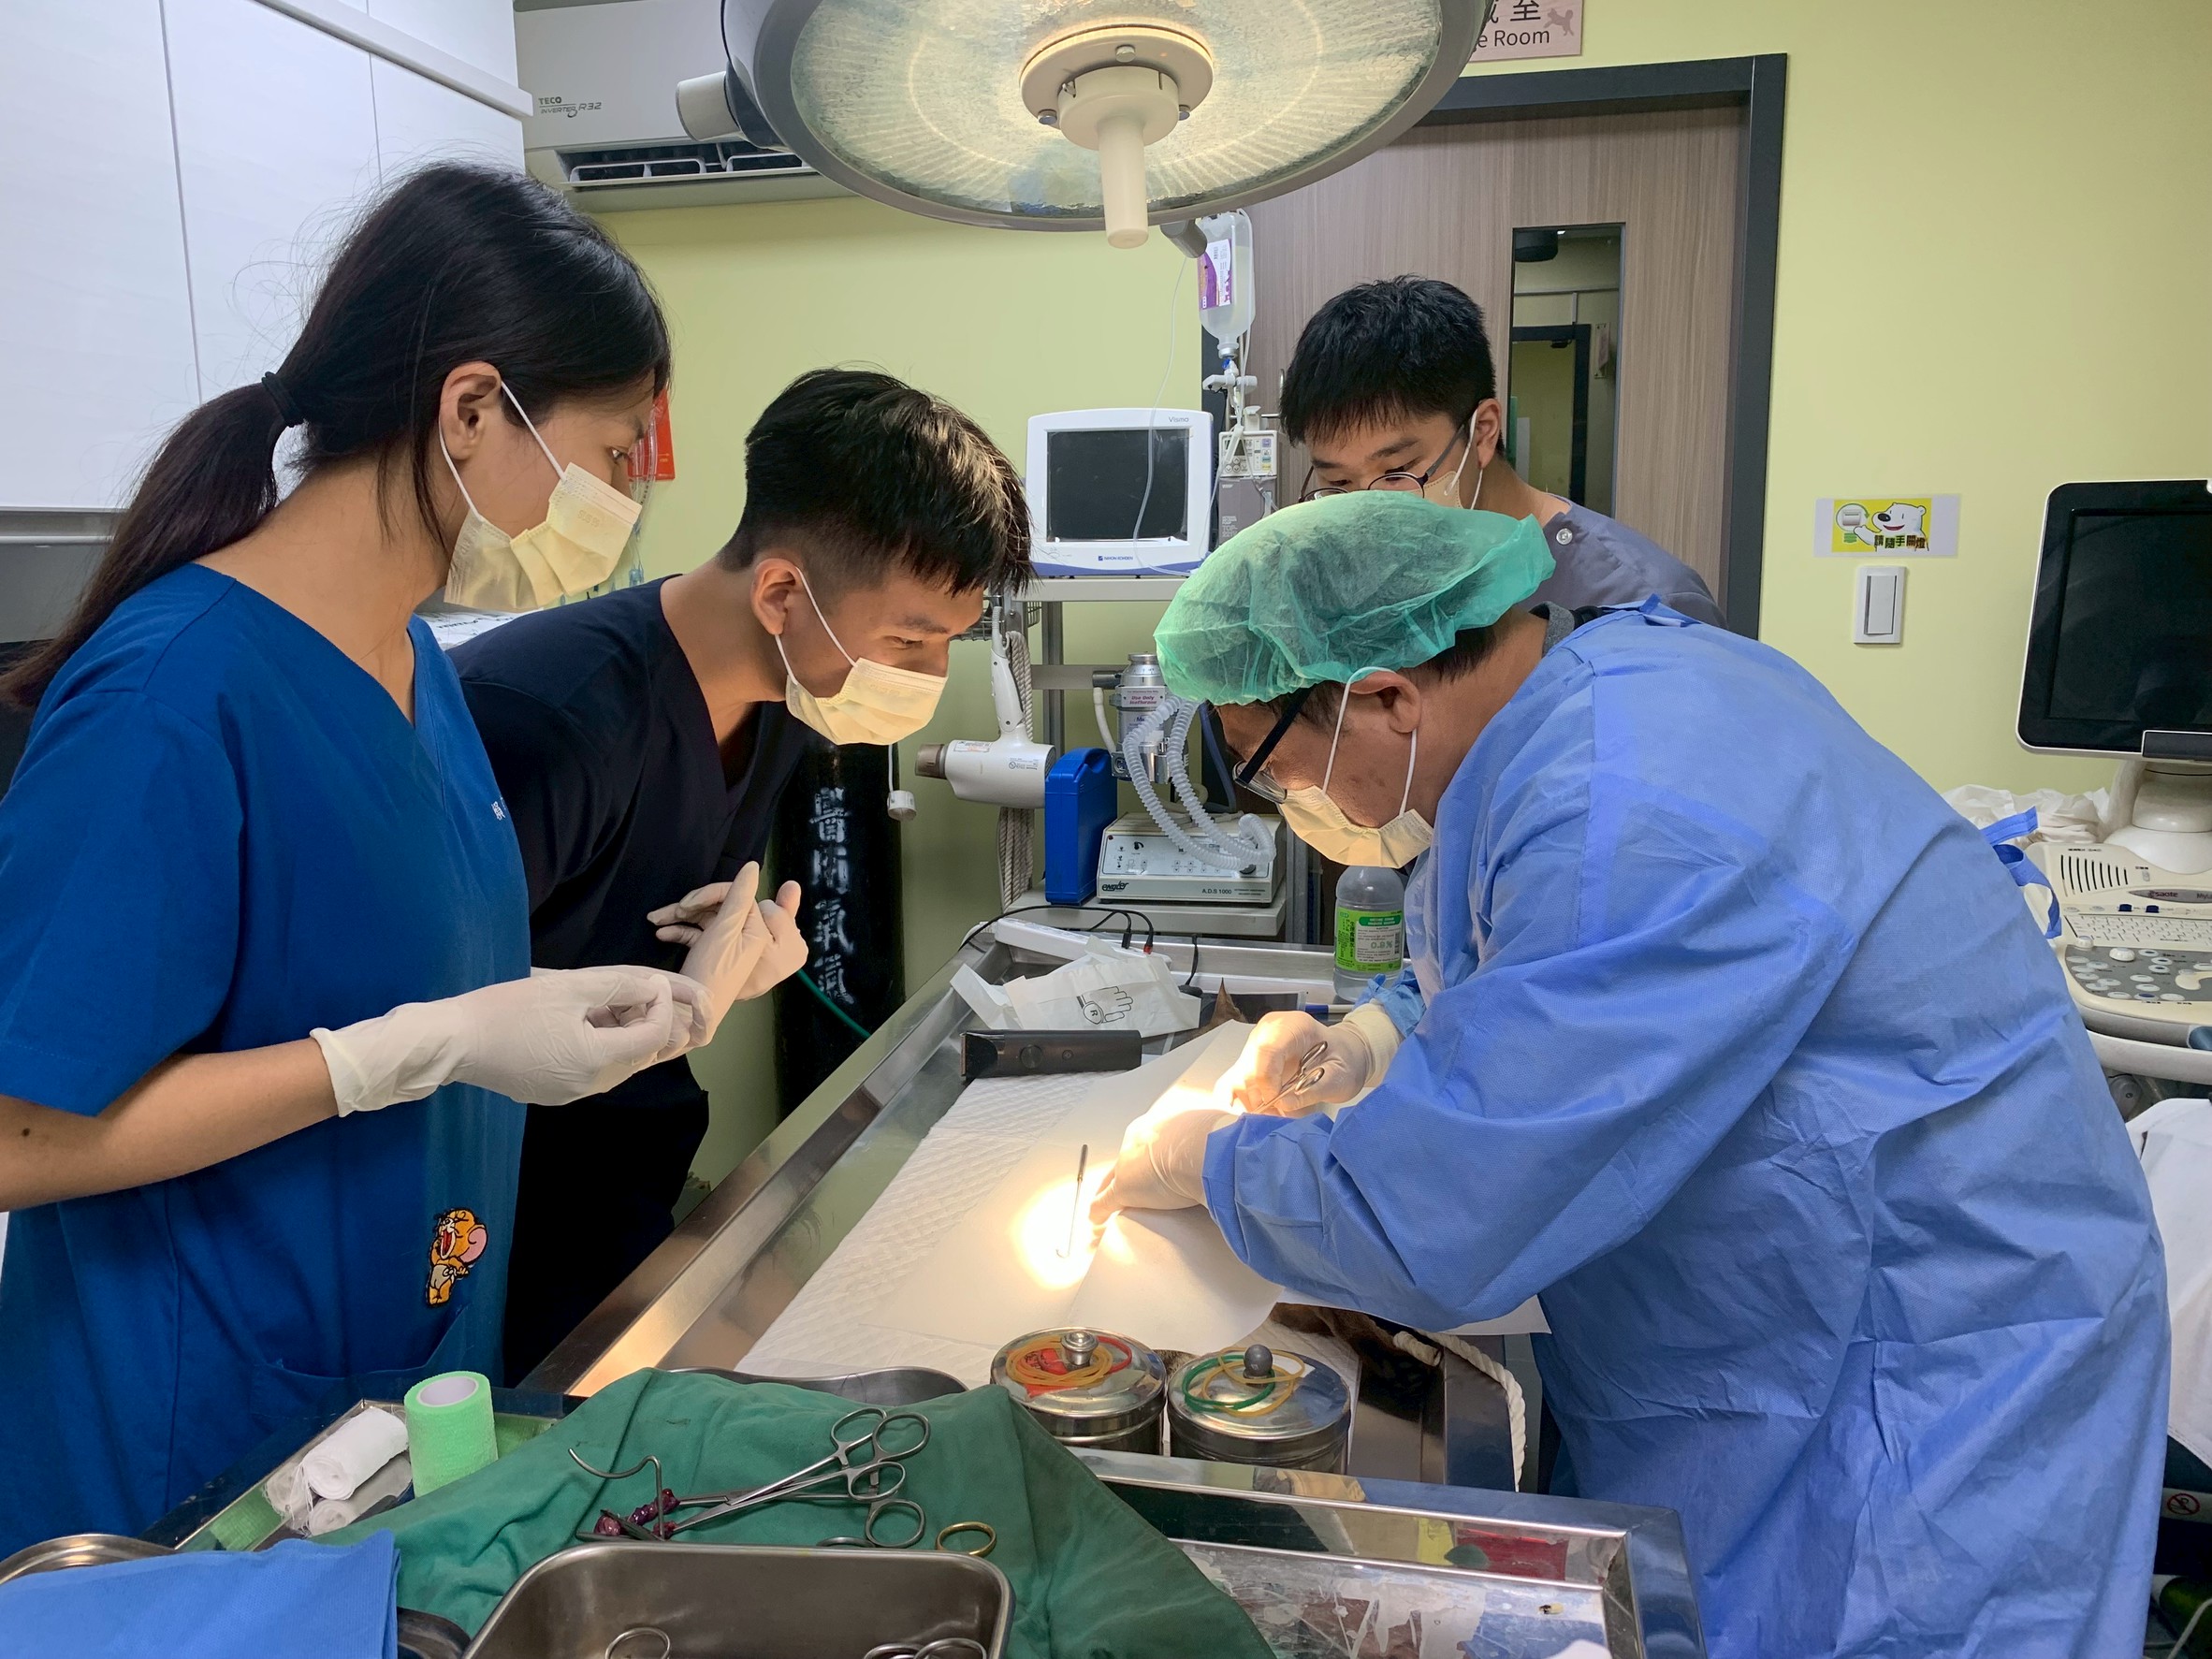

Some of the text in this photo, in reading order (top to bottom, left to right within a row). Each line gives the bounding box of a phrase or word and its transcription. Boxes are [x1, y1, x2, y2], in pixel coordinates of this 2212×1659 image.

[1494, 30, 1550, 47] Room
[538, 96, 562, 105] TECO
[578, 102, 602, 110] R32
